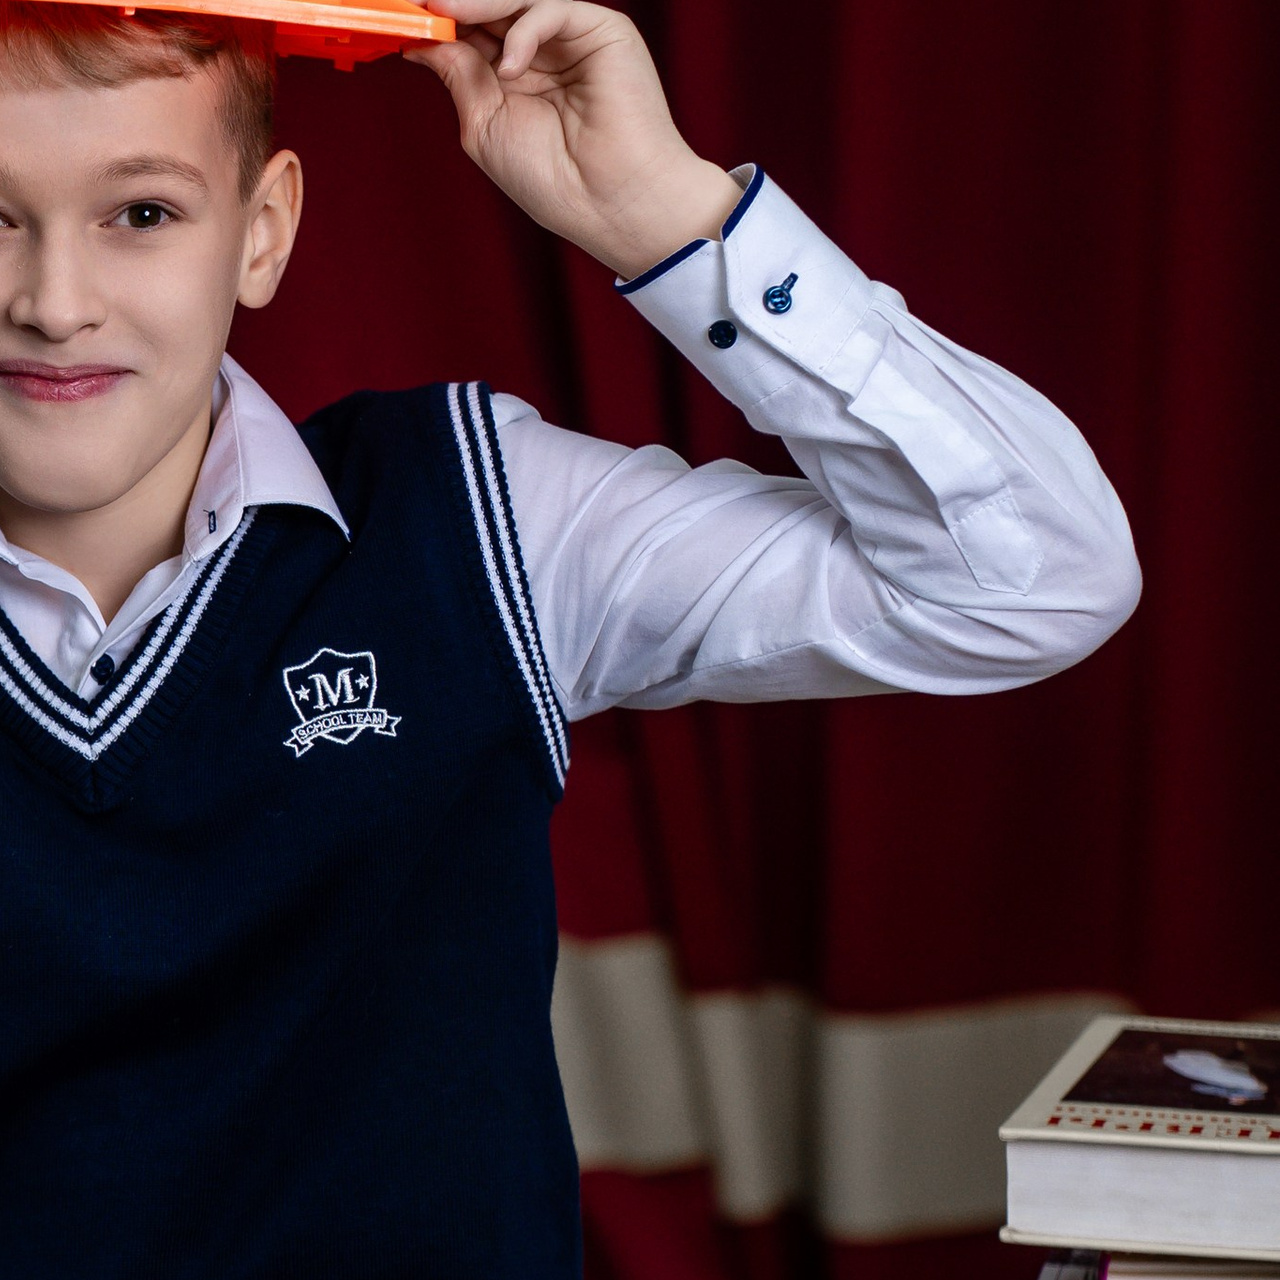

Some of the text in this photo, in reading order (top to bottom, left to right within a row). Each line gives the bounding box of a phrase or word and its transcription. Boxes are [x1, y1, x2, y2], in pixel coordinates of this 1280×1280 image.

[308, 668, 360, 711] M
[298, 713, 382, 740] SCHOOL TEAM
